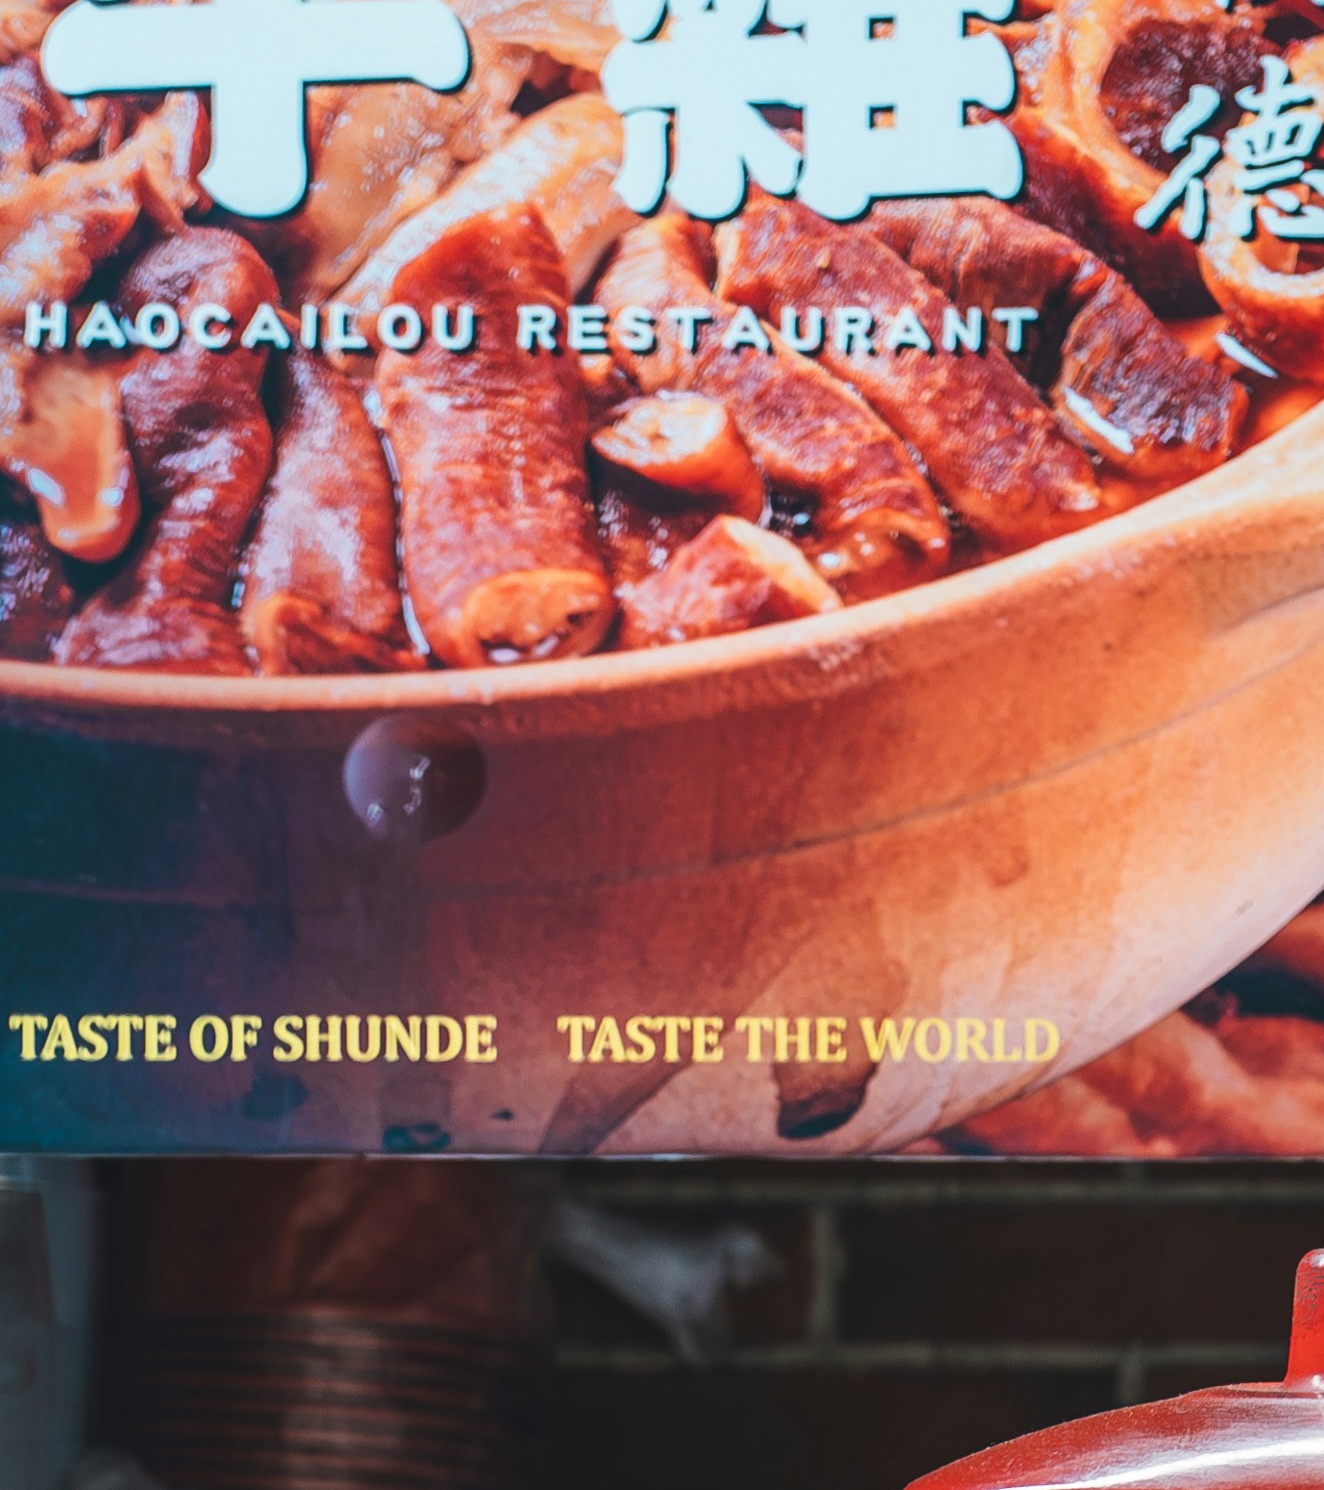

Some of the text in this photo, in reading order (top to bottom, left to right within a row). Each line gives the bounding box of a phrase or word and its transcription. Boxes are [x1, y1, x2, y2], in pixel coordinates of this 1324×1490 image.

[25, 302, 1041, 355] HAOCAILOU RESTAURANT
[9, 1013, 1061, 1065] TASTE OF SHUNDE TASTE THE WORLD
